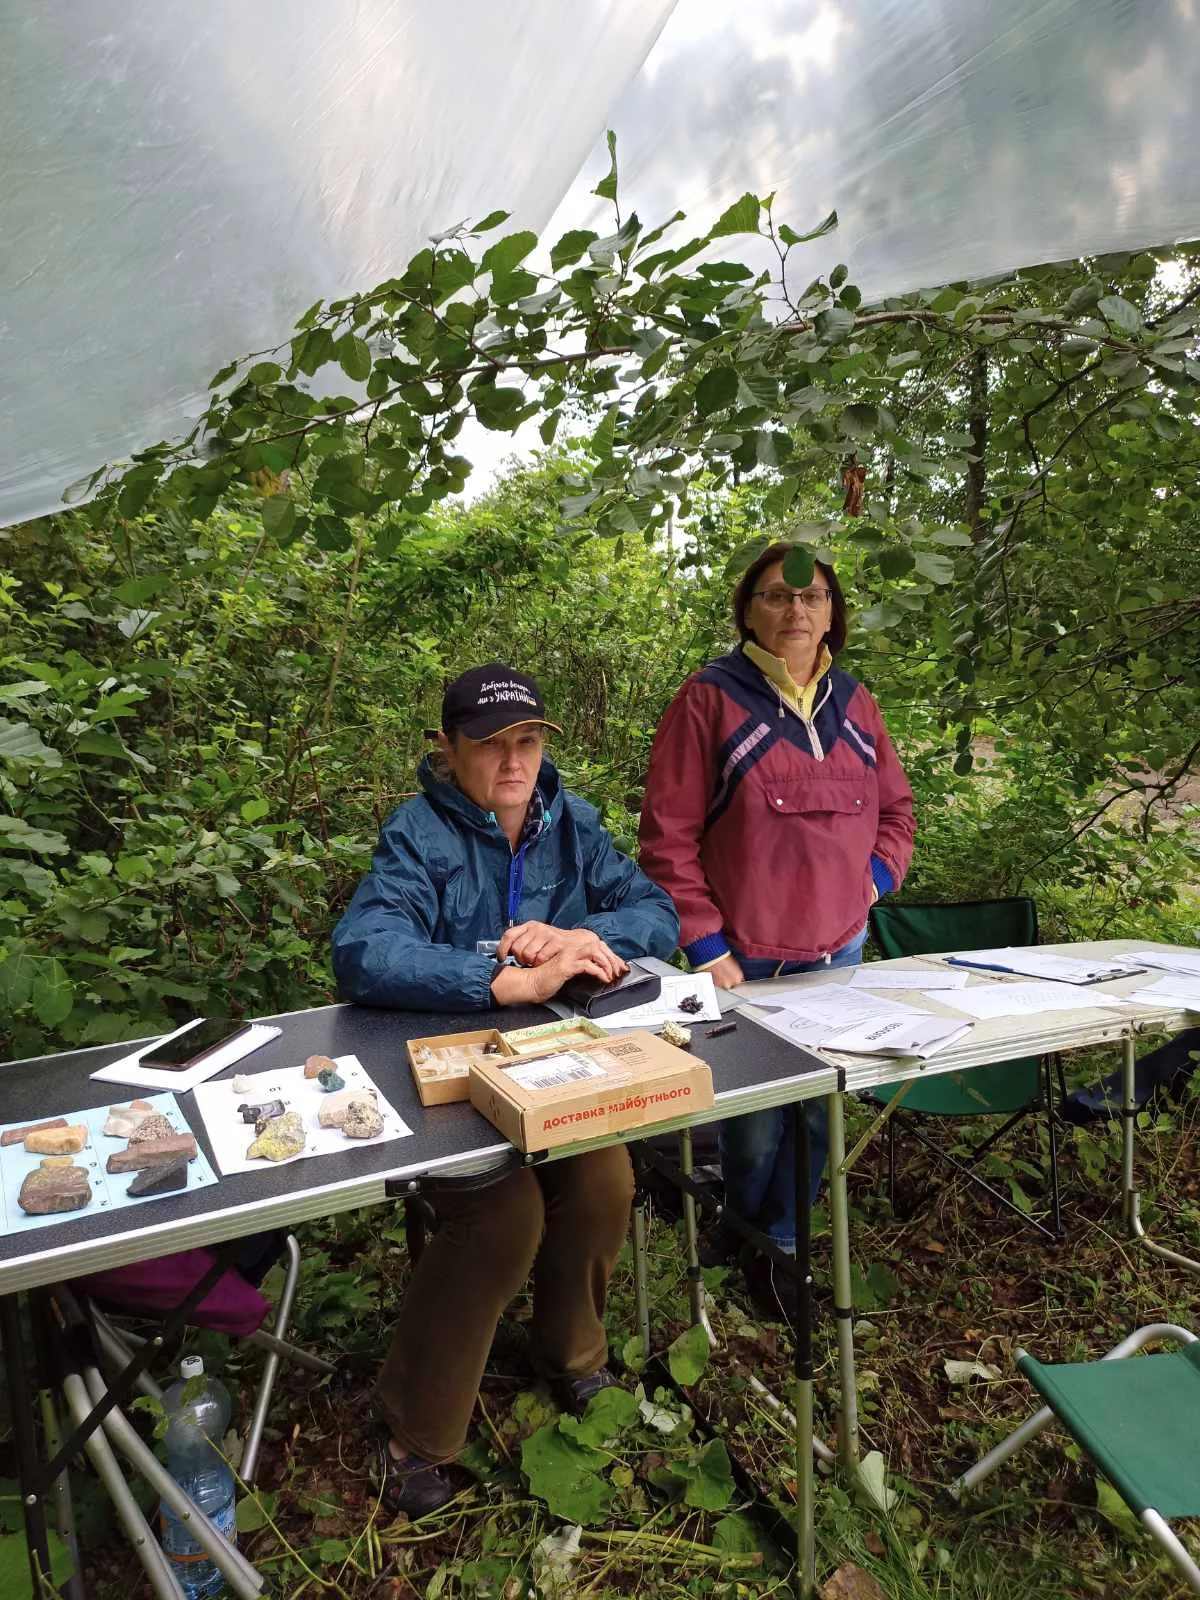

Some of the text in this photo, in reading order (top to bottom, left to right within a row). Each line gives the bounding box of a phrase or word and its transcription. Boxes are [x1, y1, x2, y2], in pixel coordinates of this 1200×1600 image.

[495, 689, 529, 703] УКРАЇНИ
[543, 1087, 691, 1131] доставка майбутнього
